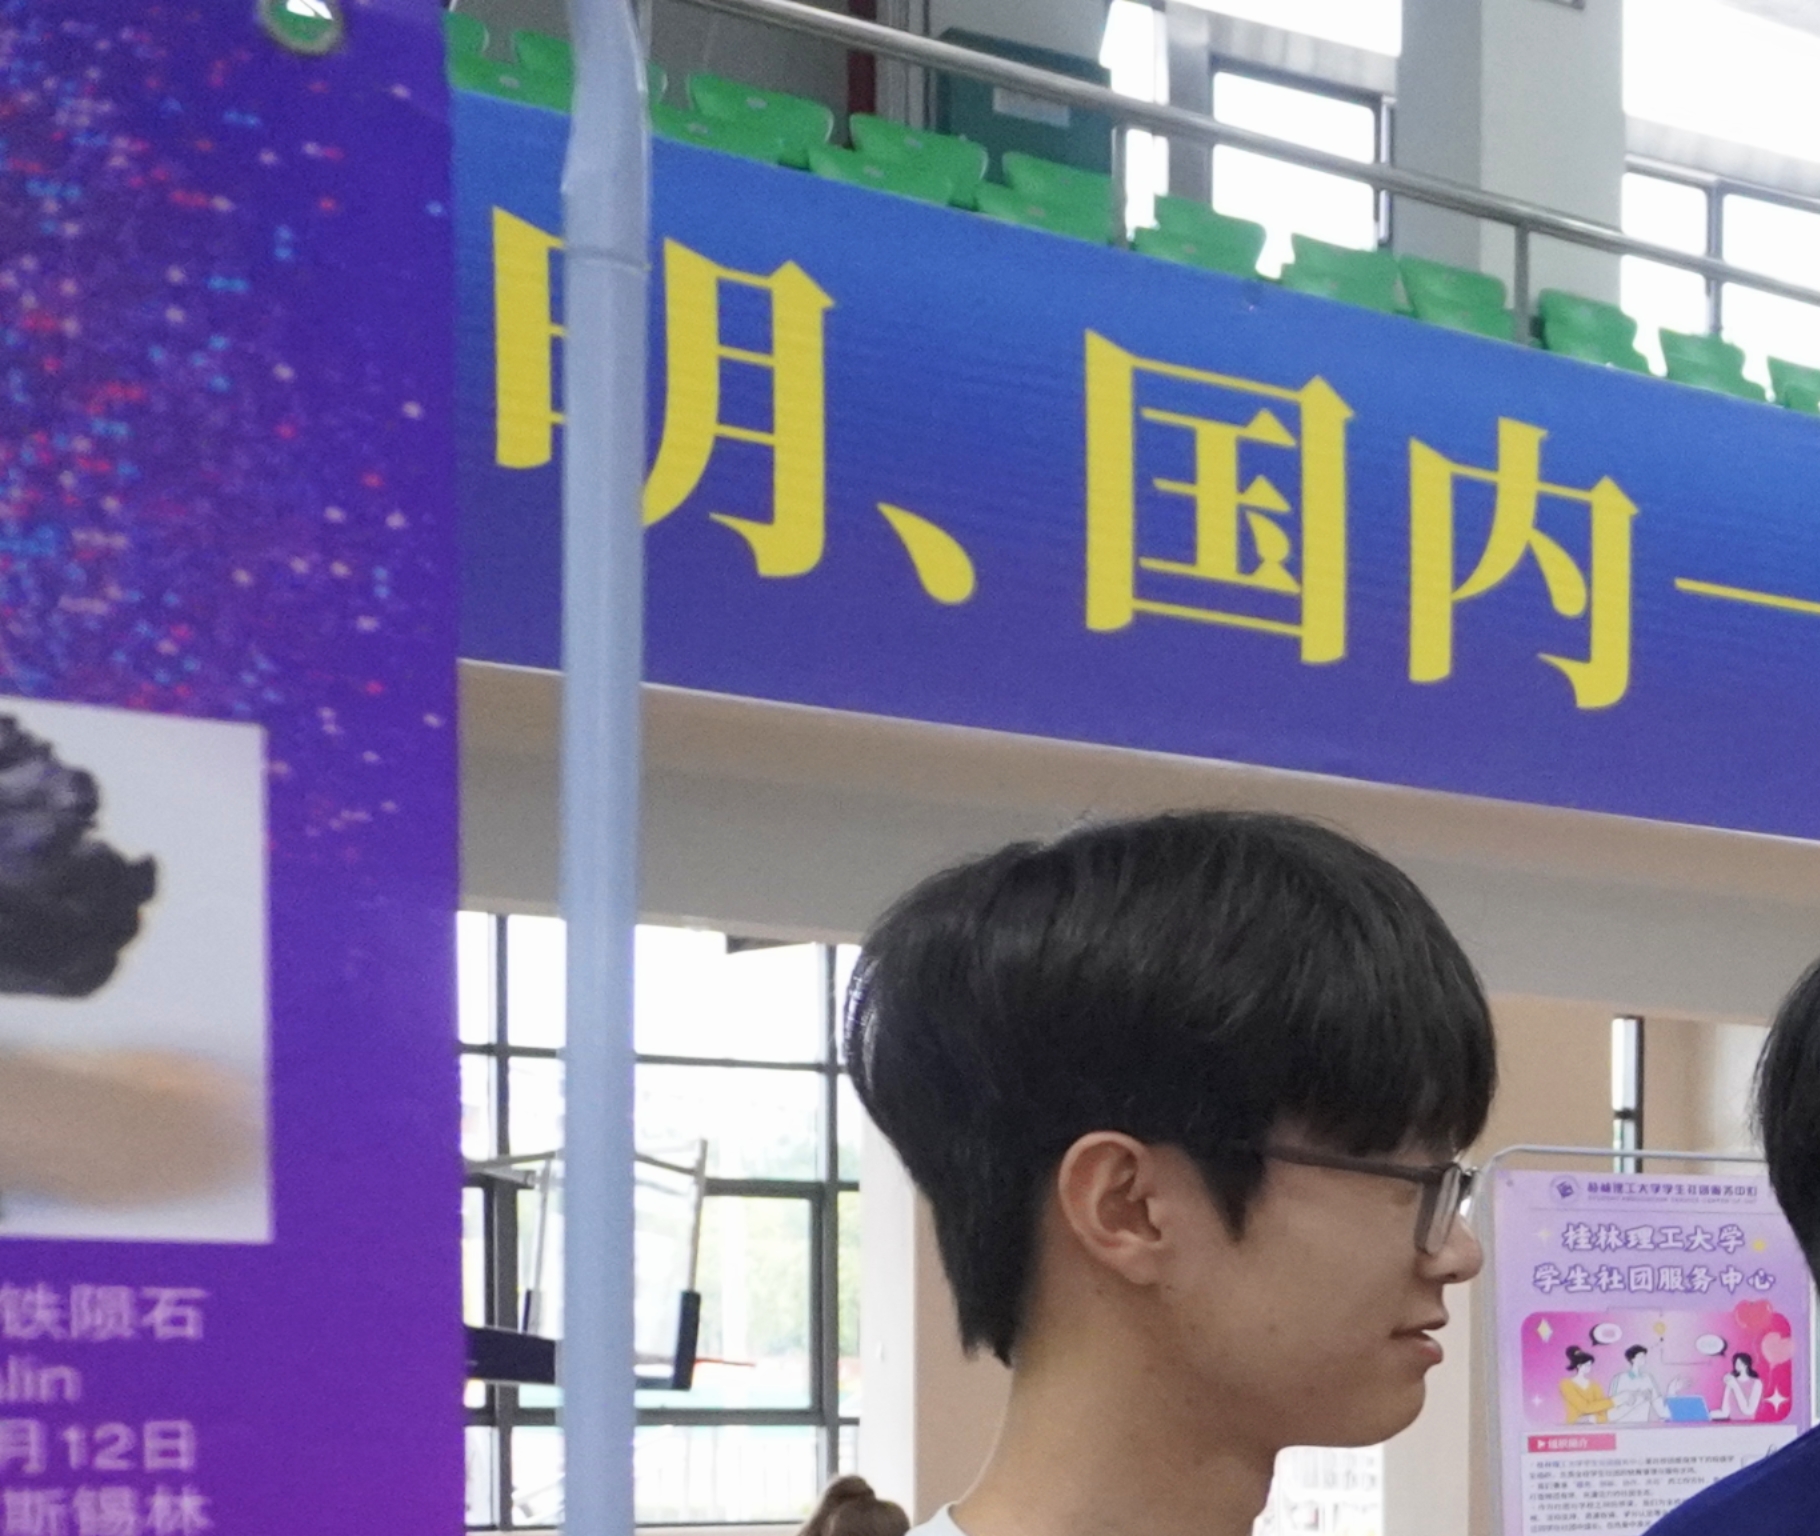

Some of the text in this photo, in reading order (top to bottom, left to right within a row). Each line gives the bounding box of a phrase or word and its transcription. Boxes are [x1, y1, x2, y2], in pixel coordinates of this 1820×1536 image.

[1562, 1222, 1746, 1255] 桂林理工大学
[1533, 1264, 1776, 1294] 学生社团服务中心
[0, 1354, 82, 1403] lin
[0, 1417, 197, 1474] 月12日
